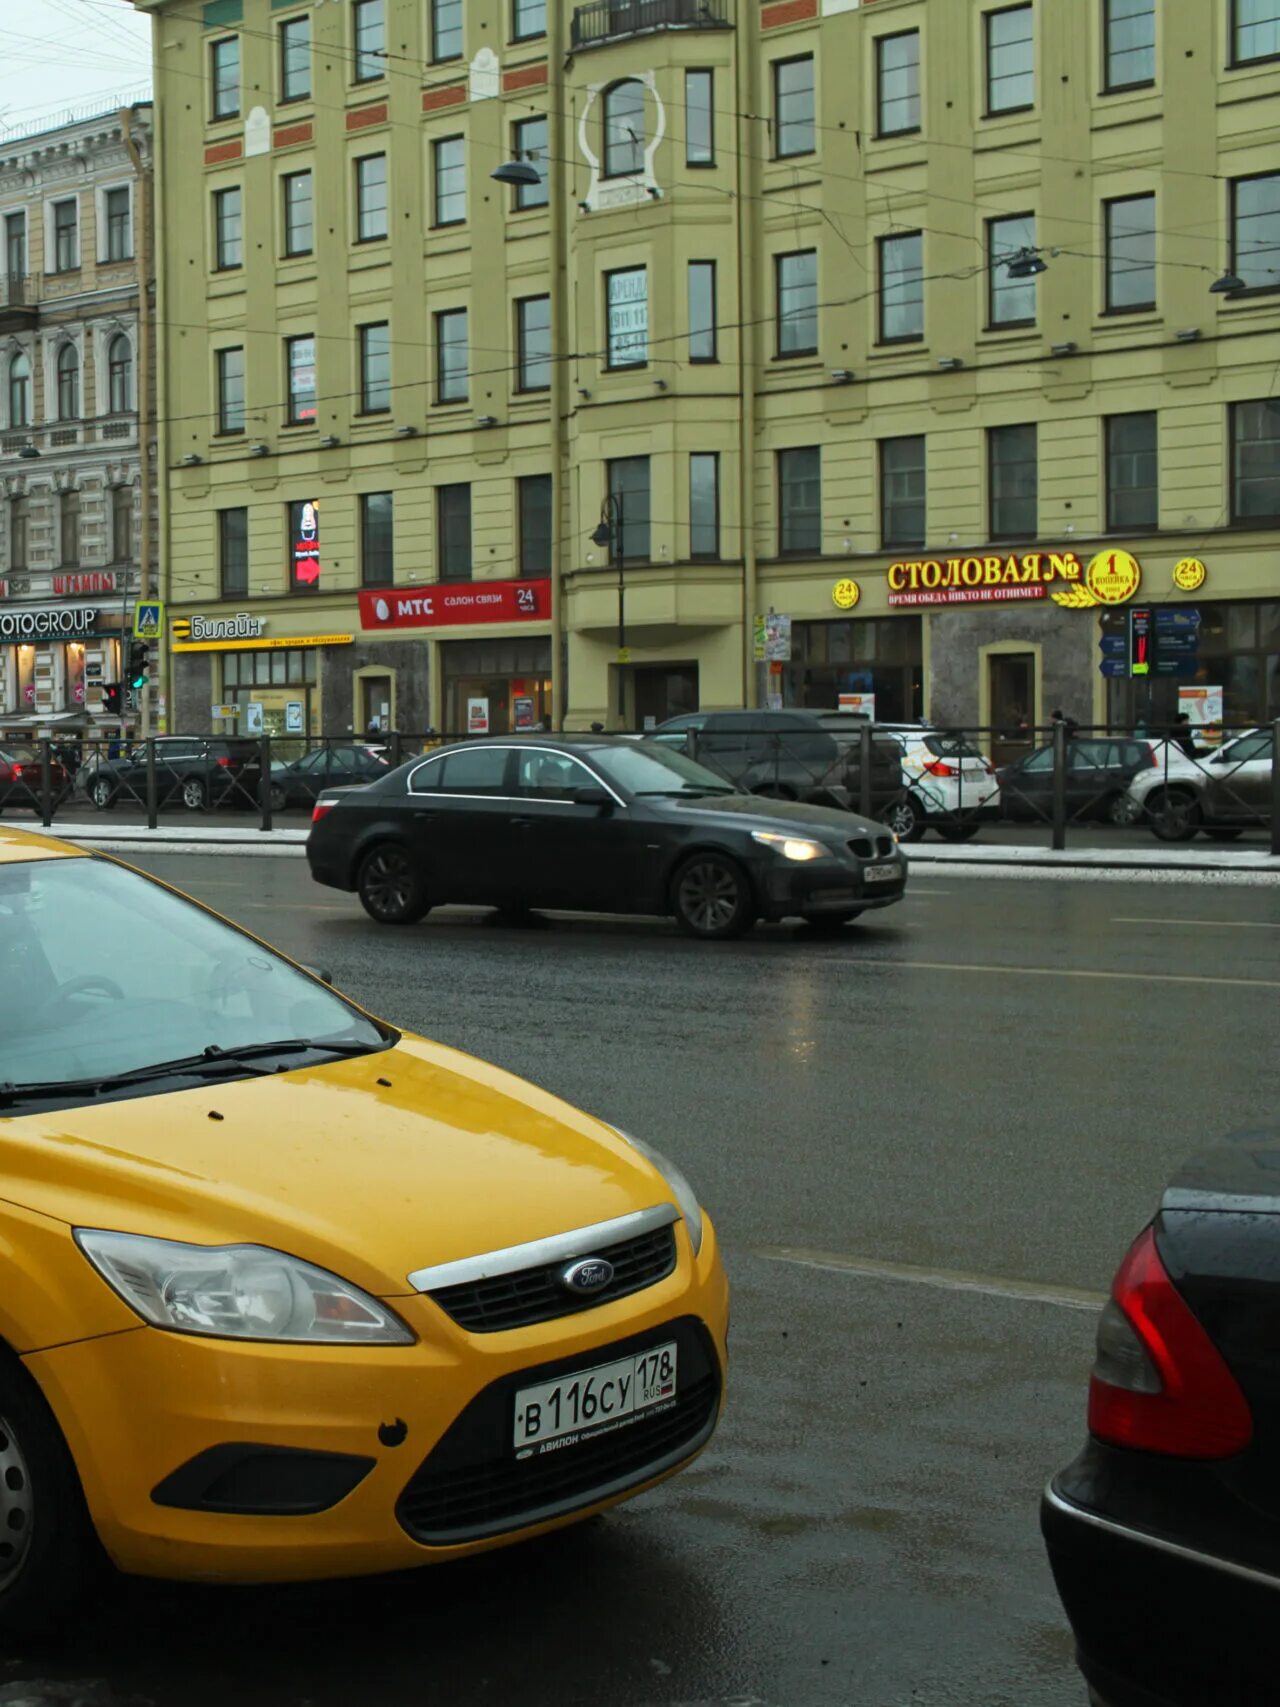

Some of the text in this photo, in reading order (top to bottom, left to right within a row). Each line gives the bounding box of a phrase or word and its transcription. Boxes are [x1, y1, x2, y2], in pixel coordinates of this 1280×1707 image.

[887, 553, 1117, 590] СТОЛОВАЯ № 1
[1180, 562, 1197, 574] 24
[53, 572, 115, 594] ШТАМПЫ
[838, 584, 852, 594] 24
[444, 594, 502, 606] салон связи
[517, 589, 534, 604] 24
[948, 590, 980, 601] НИКТО
[983, 590, 994, 599] НЕ
[398, 598, 434, 616] МТС
[192, 613, 262, 638] Билайн
[581, 1265, 605, 1286] Ford
[637, 1350, 671, 1389] 178
[643, 1384, 662, 1401] RUS
[539, 1434, 579, 1454] АВИЛОН
